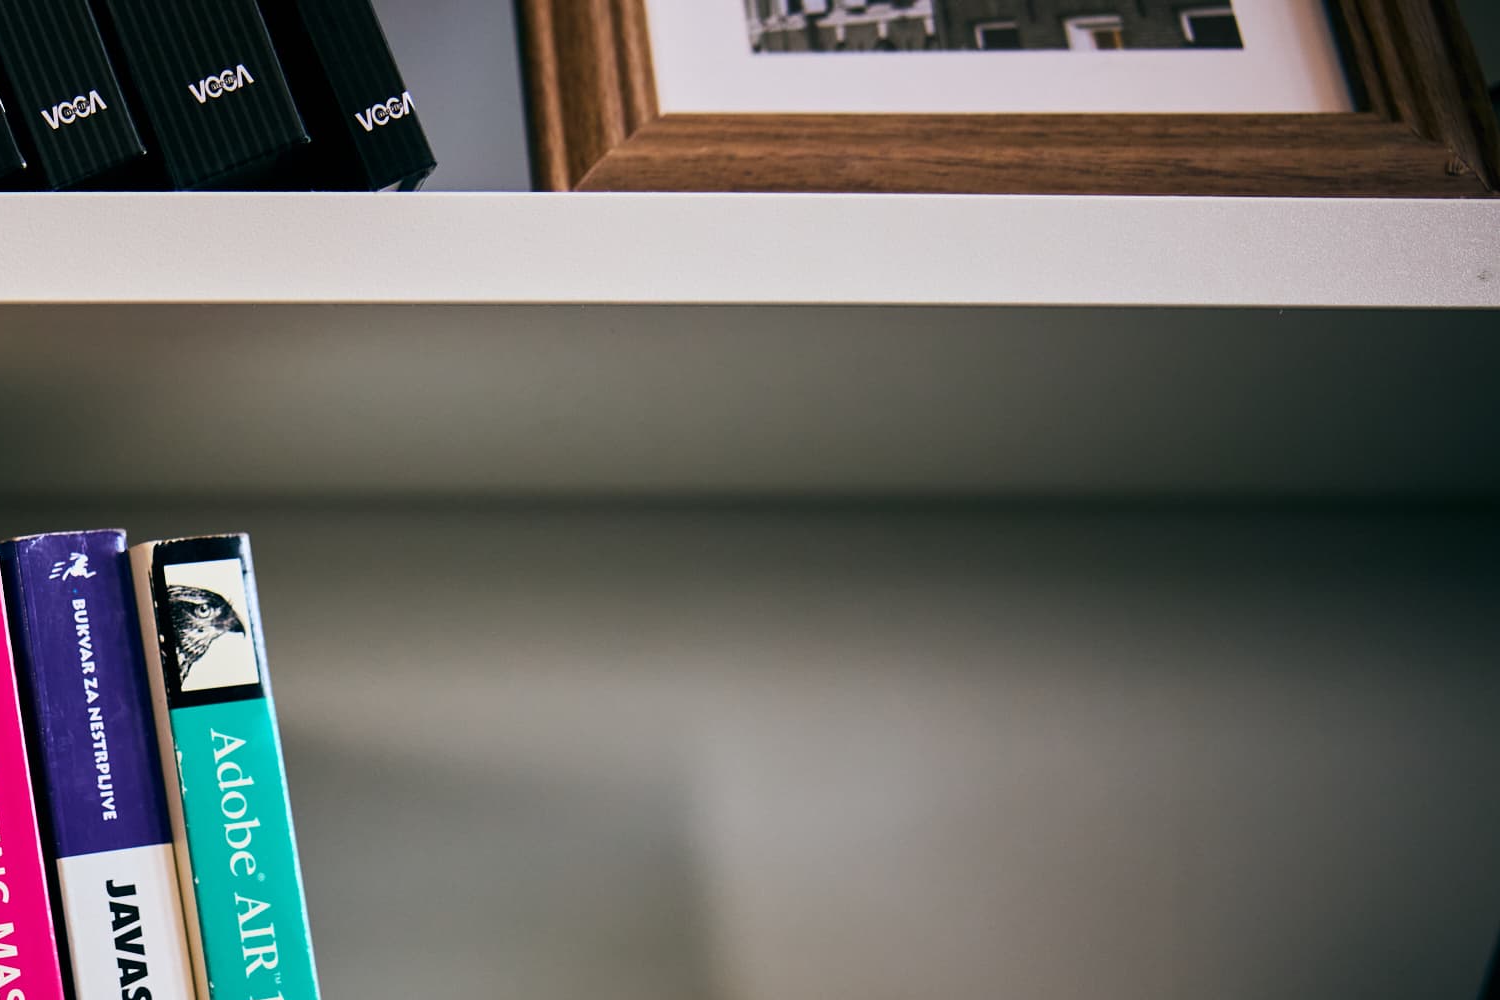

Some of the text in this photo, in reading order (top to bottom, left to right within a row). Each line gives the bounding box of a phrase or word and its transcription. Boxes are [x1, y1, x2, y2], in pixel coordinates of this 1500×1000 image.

[72, 598, 117, 821] BUKVAR ZA NESTRPLJIVE
